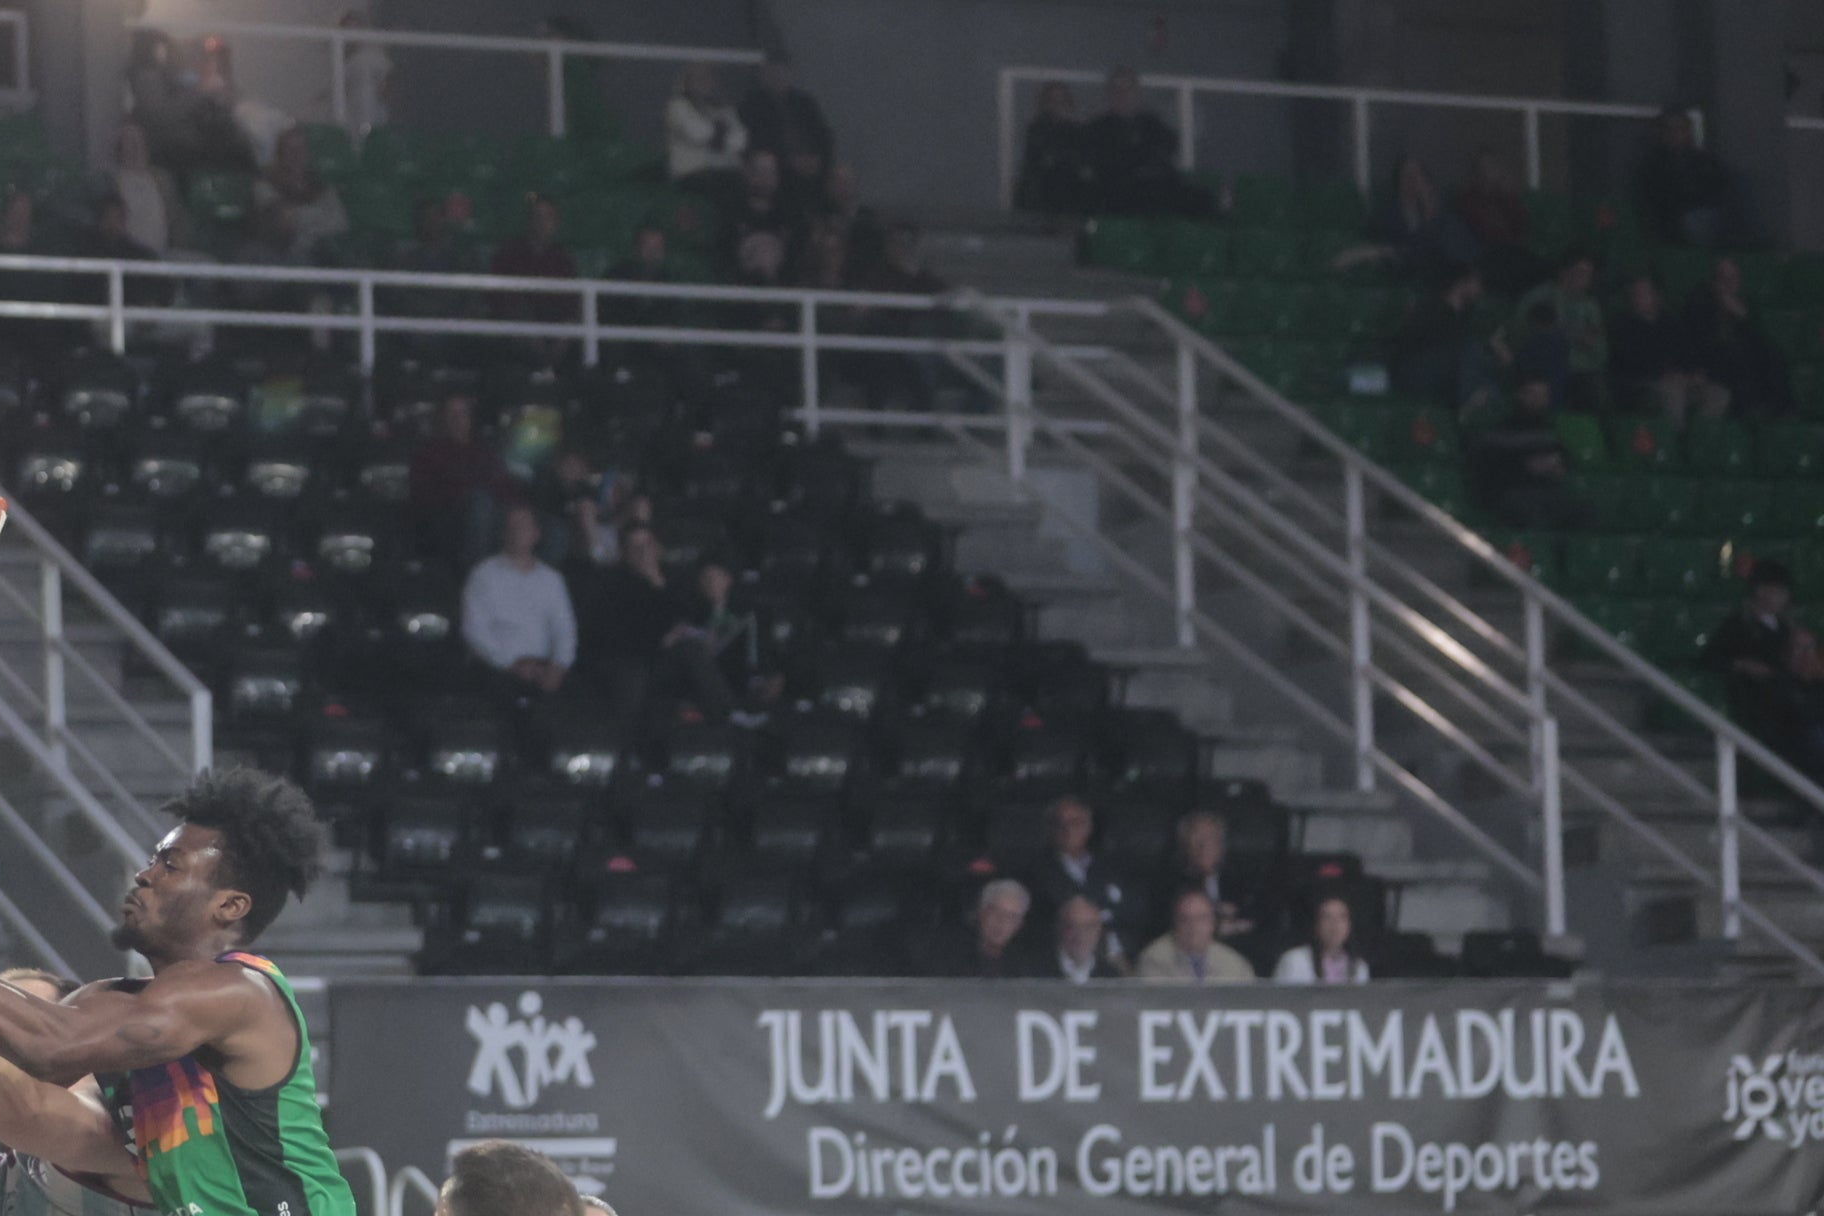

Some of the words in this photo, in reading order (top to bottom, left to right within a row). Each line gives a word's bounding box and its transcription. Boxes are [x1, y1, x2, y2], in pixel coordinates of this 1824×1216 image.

[757, 1009, 977, 1119] JUNTA
[1015, 1009, 1102, 1101] DE
[1137, 1007, 1640, 1101] EXTREMADURA
[807, 1124, 1059, 1199] Dirección
[1077, 1122, 1276, 1196] General
[1293, 1122, 1355, 1195] de
[1371, 1122, 1601, 1213] Deportes
